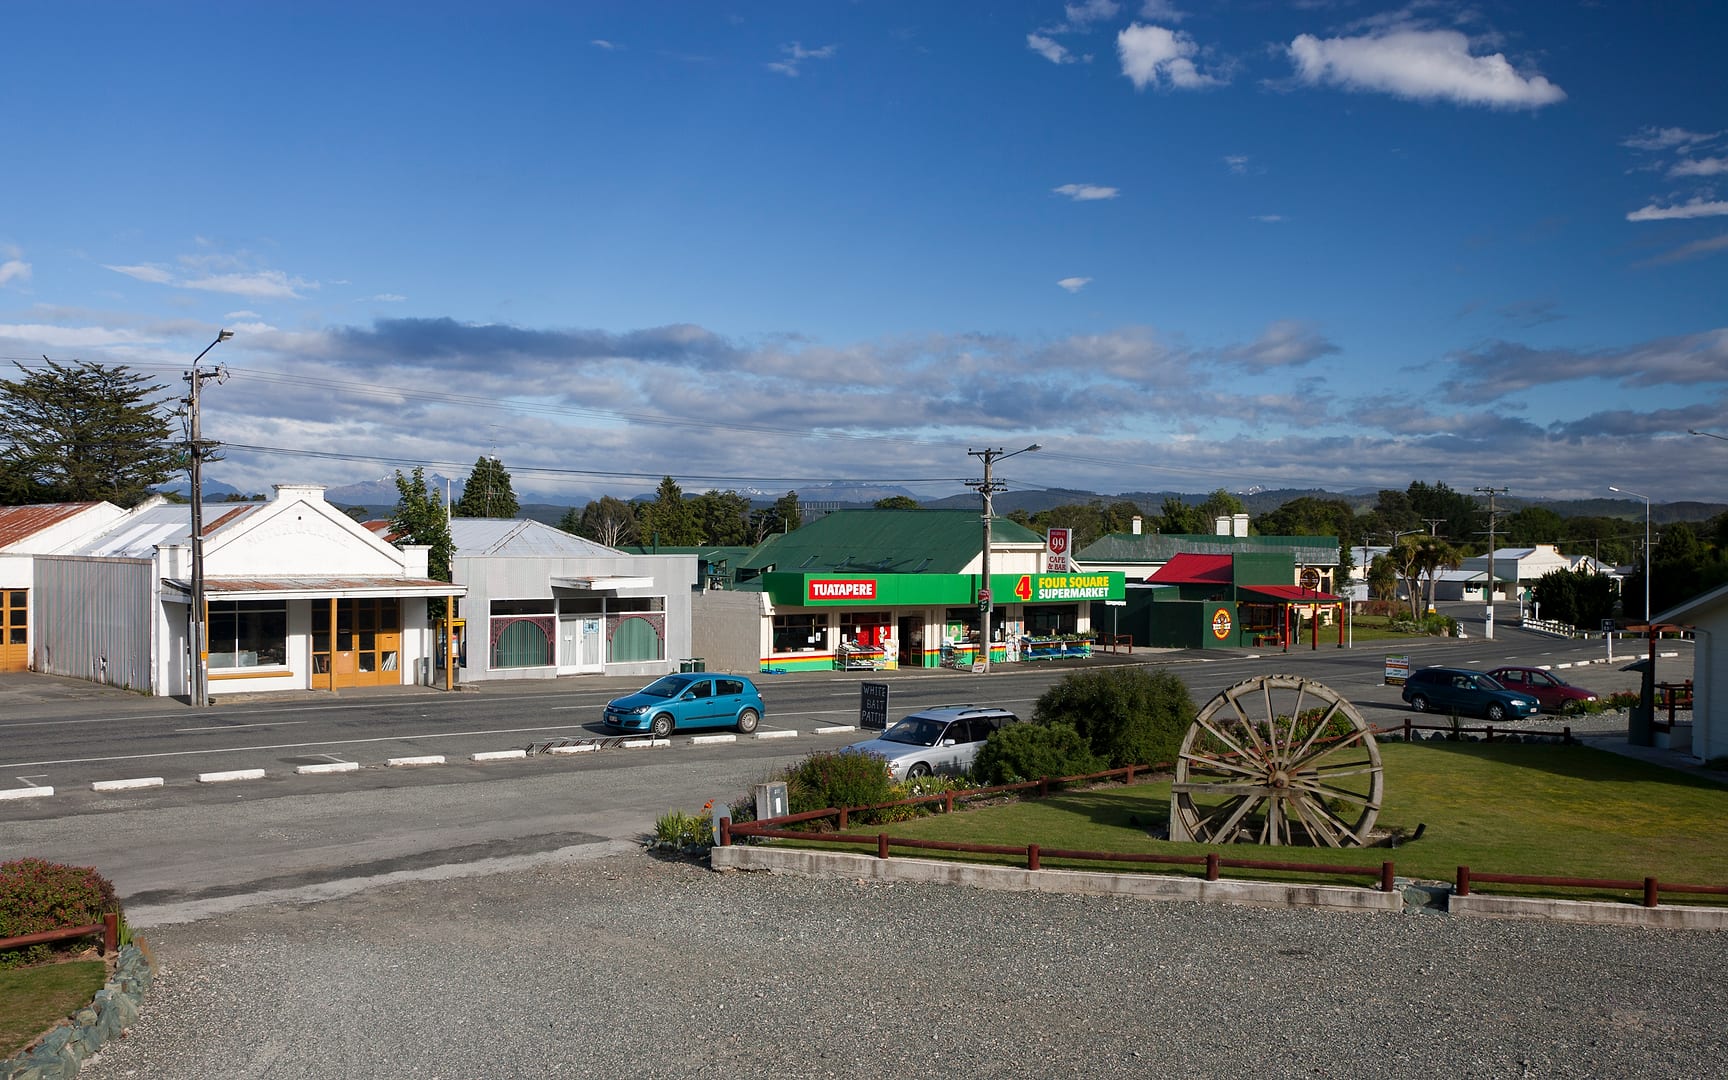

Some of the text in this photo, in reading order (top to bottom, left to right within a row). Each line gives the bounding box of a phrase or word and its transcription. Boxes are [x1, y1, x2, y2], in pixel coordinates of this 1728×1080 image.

[1052, 537, 1065, 550] 99
[1054, 563, 1067, 571] BAR
[1015, 575, 1032, 601] 4
[1038, 576, 1109, 588] FOUR SQUARE
[813, 583, 873, 596] TUATAPERE
[1038, 587, 1109, 599] SUPERMARKET
[863, 685, 886, 697] WHITE
[866, 699, 885, 710] BAIT
